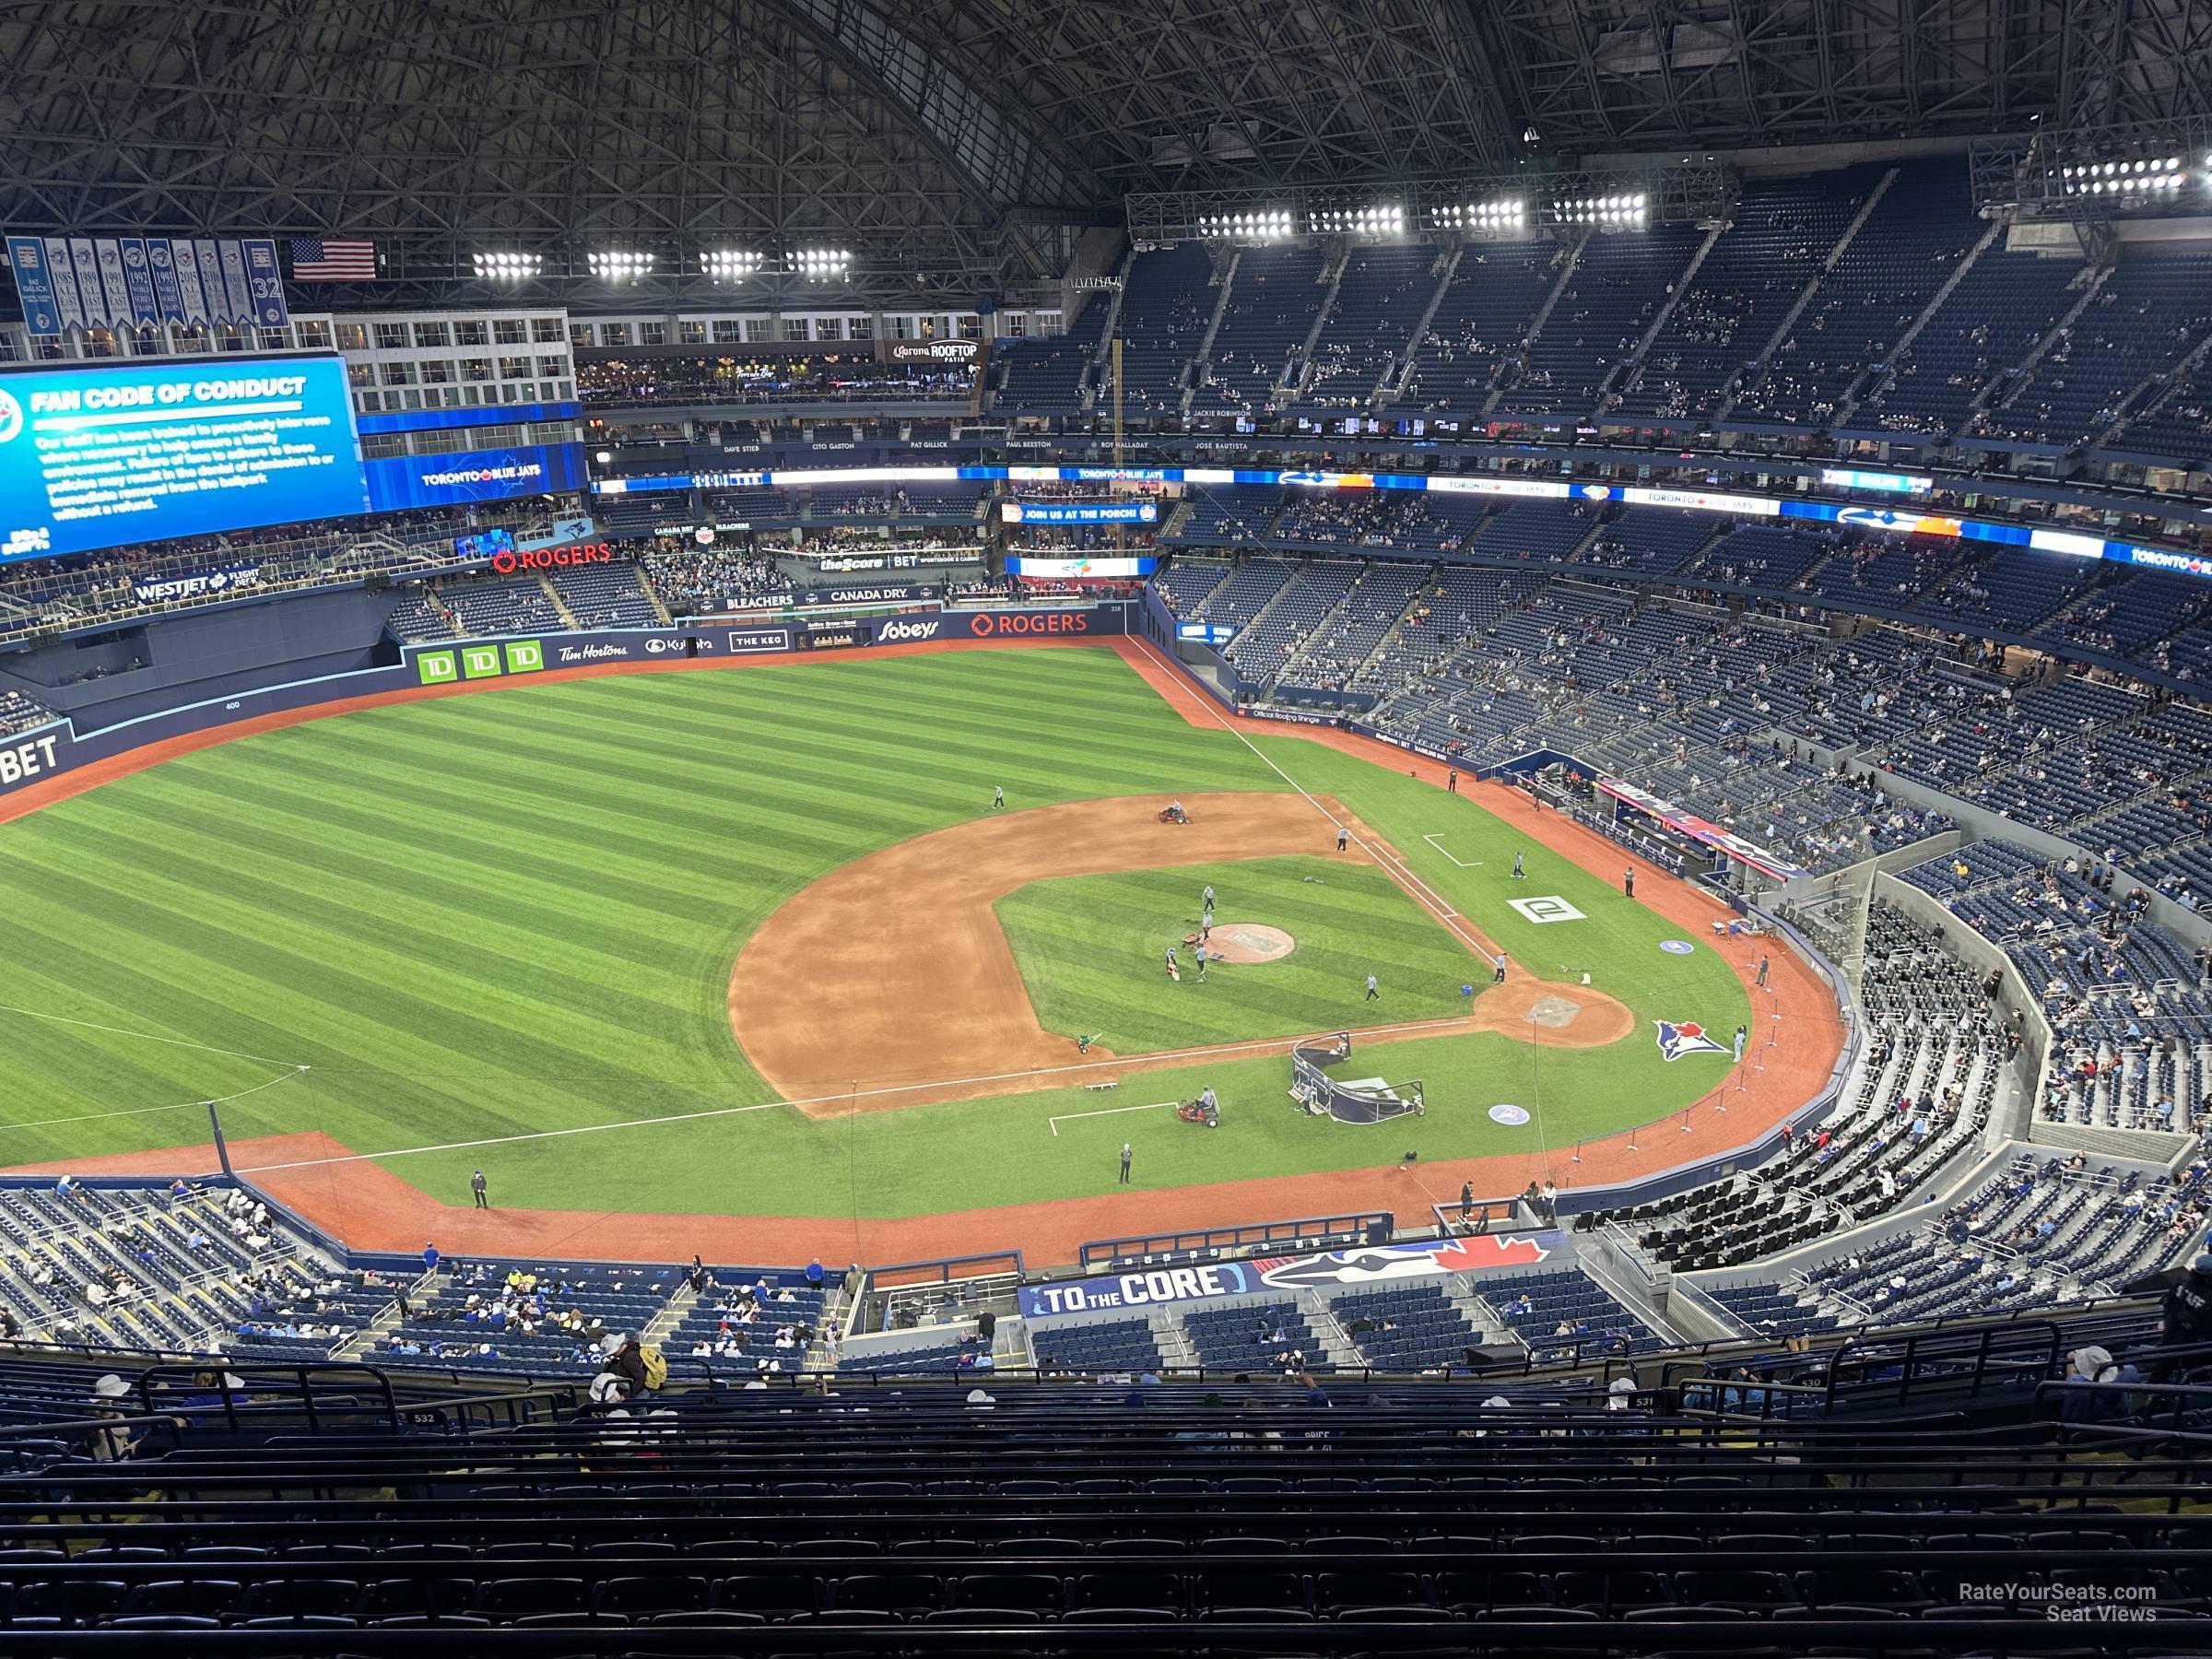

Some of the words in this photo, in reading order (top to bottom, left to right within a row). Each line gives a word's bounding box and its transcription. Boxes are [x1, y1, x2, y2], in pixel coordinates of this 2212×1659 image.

[129, 272, 148, 283] 1992
[156, 272, 174, 283] 1993
[253, 277, 282, 299] 32
[892, 345, 930, 359] Corona
[931, 345, 977, 358] ROOFTOP
[30, 389, 81, 413] FAN
[84, 384, 155, 410] CODE
[157, 382, 192, 404] OF
[194, 377, 307, 401] CONDUCT
[422, 470, 480, 486] TORONTO
[491, 467, 516, 480] BLUE
[517, 465, 541, 477] JAYS
[1079, 470, 1118, 479] TORONTO
[1125, 470, 1144, 479] BLUE
[1145, 470, 1164, 479] JAYS
[1449, 481, 1492, 490] TORONTO
[1648, 493, 1695, 504] TORONTO
[1025, 510, 1047, 519] JOIN
[1050, 510, 1063, 519] US
[1065, 511, 1077, 519] AT
[1079, 510, 1098, 519] THE
[1100, 509, 1136, 518] PORCH!
[654, 527, 681, 535] CANADA
[521, 542, 611, 568] ROGERS
[2131, 549, 2190, 570] TORONTO
[820, 558, 883, 571] theScore
[894, 555, 918, 567] BET
[229, 568, 260, 581] FLIGHT
[135, 577, 209, 600] WESTJET
[831, 590, 882, 602] CANADA
[726, 594, 794, 610] BLEACHERS
[877, 621, 939, 641] Sobeys
[999, 614, 1088, 634] ROGERS
[760, 636, 782, 644] KEG
[510, 646, 539, 666] TD
[559, 646, 582, 662] Tim
[582, 644, 628, 659] Hortons
[422, 657, 453, 677] TD
[466, 652, 496, 671] TD
[225, 700, 241, 710] 400
[1253, 710, 1274, 718] Official
[1298, 714, 1320, 724] Shingle
[0, 735, 56, 784] BET
[1043, 1287, 1087, 1313] TO
[1087, 1293, 1121, 1309] THE
[1119, 1265, 1226, 1305] CORE
[1801, 1378, 1821, 1387] 530
[1636, 1396, 1653, 1407] 531
[414, 1414, 435, 1423] 532
